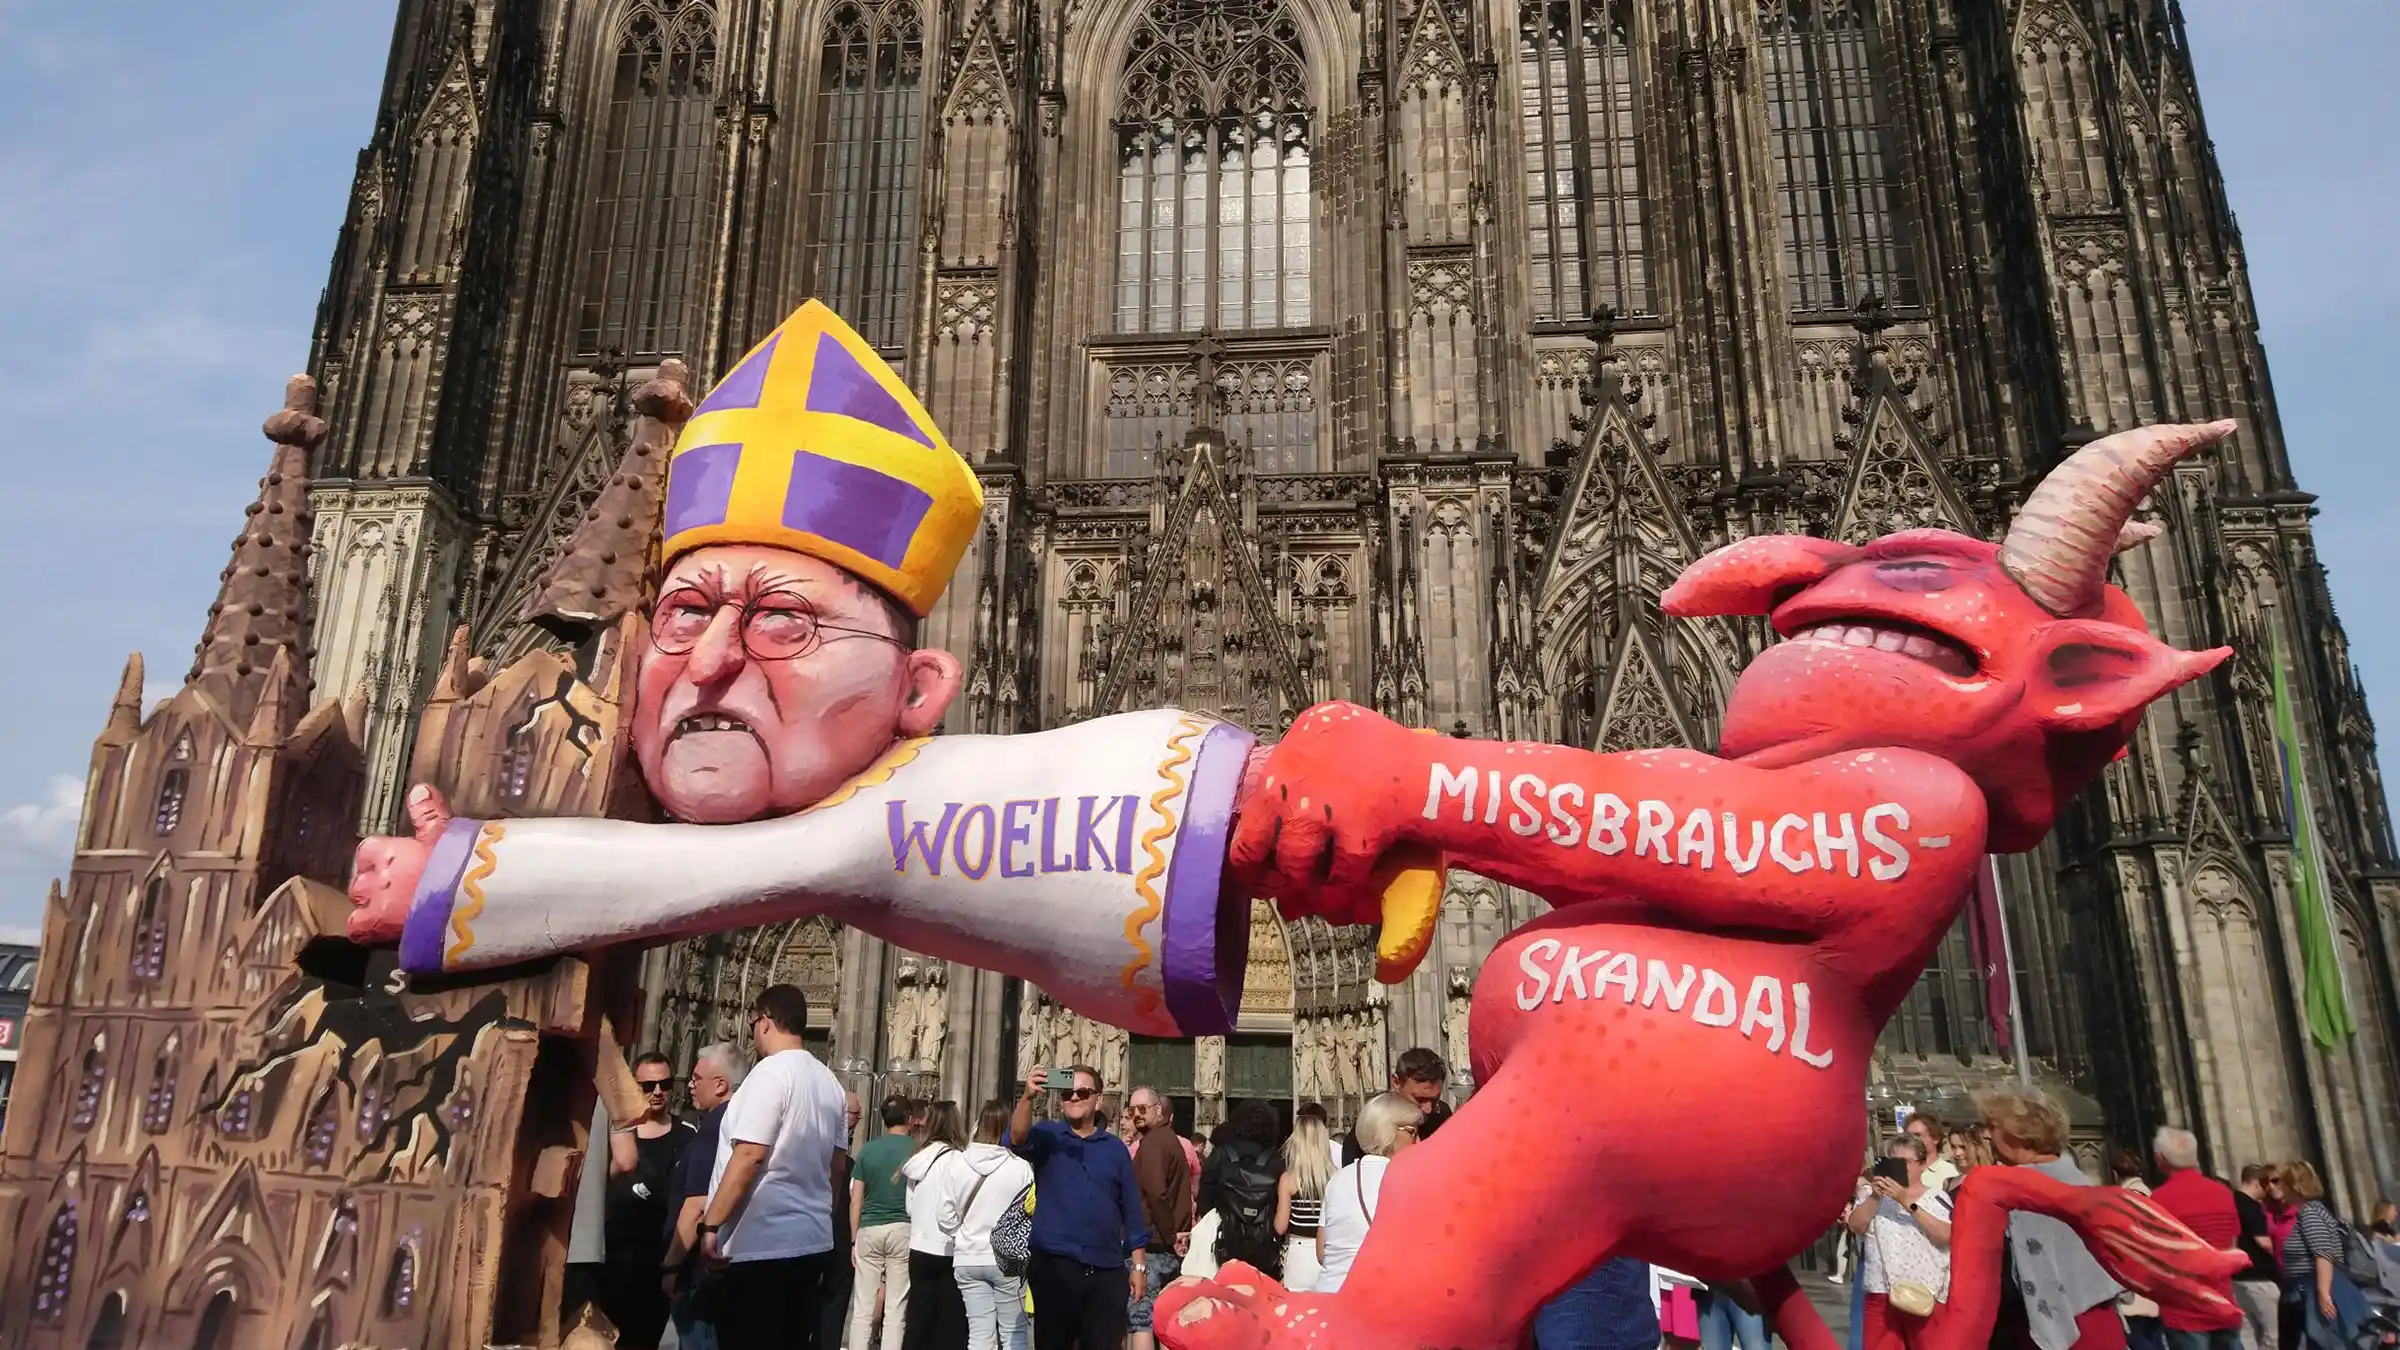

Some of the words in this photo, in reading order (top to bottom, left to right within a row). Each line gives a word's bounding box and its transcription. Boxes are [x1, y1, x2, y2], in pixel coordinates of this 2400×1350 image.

[885, 795, 1141, 881] WOELKI
[1421, 762, 1951, 882] MISSBRAUCHS-
[1516, 938, 1833, 1069] SKANDAL
